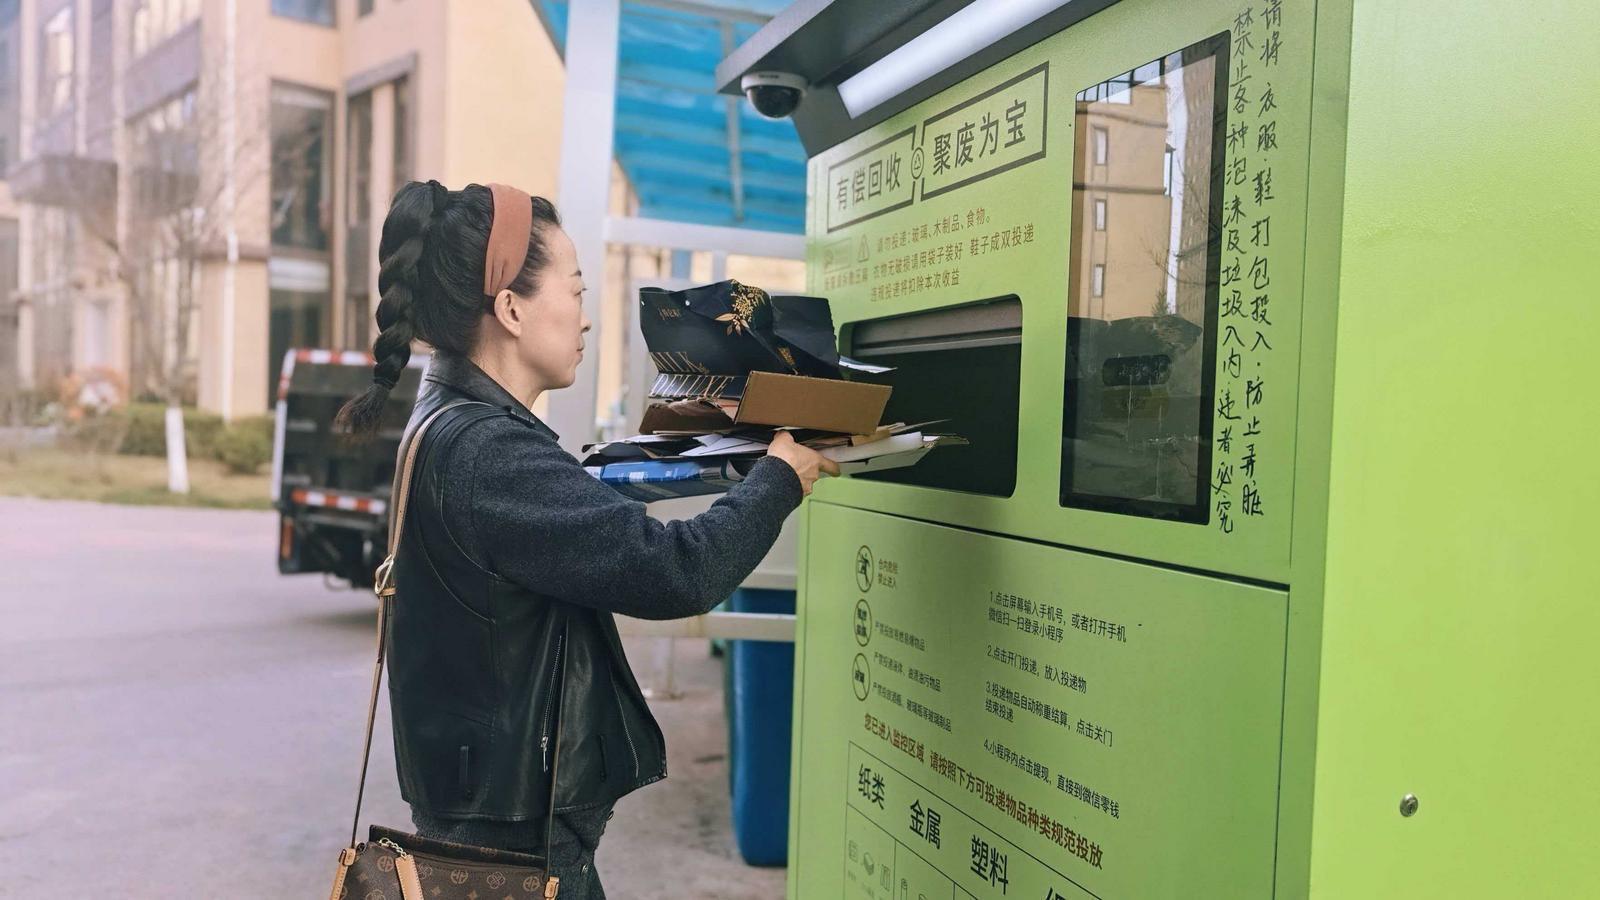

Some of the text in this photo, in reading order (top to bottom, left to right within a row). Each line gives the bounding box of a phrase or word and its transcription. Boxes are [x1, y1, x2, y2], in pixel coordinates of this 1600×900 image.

[933, 99, 1028, 175] 聚废为宝
[836, 152, 902, 210] 有偿回收
[970, 222, 1035, 257] 鞋子成双投递
[870, 269, 960, 302] 违规投递将扣除本次收益
[988, 607, 1064, 643] 微信扫一扫登录小程序
[985, 700, 1014, 723] 结束投递
[857, 763, 886, 810] 纸类
[864, 712, 1104, 871] 您已进入监控区域 请按照下方可投递物品种类规范投放
[909, 799, 941, 850] 金属
[969, 834, 1009, 896] 塑料
